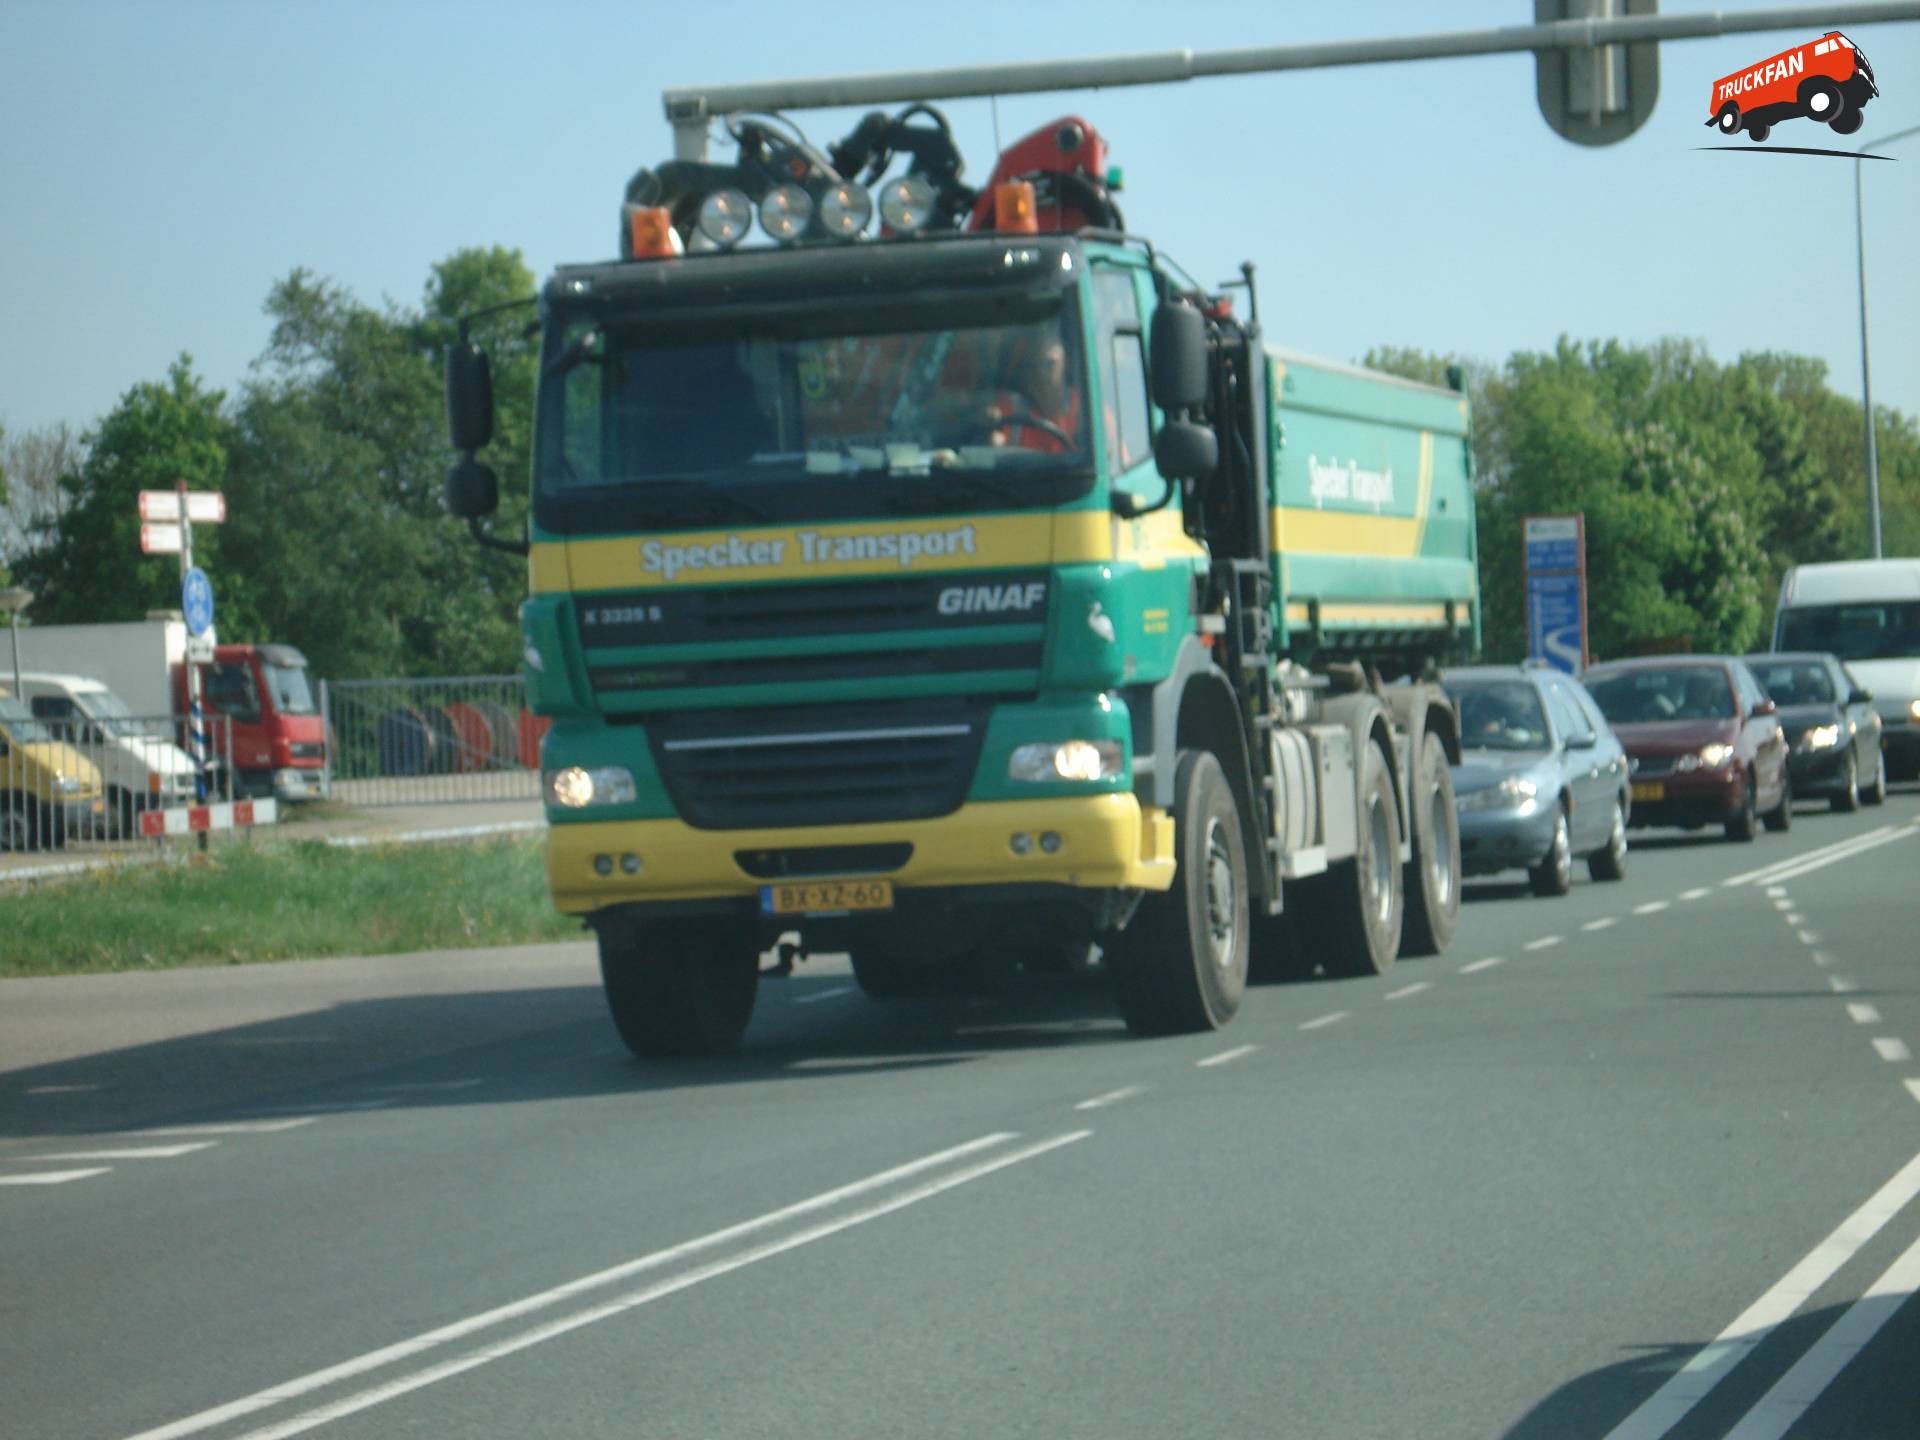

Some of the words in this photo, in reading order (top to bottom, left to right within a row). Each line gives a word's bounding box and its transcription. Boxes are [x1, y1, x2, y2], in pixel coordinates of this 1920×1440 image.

[641, 535, 787, 580] Specker
[797, 524, 977, 566] Transport
[937, 583, 1045, 616] GINAF
